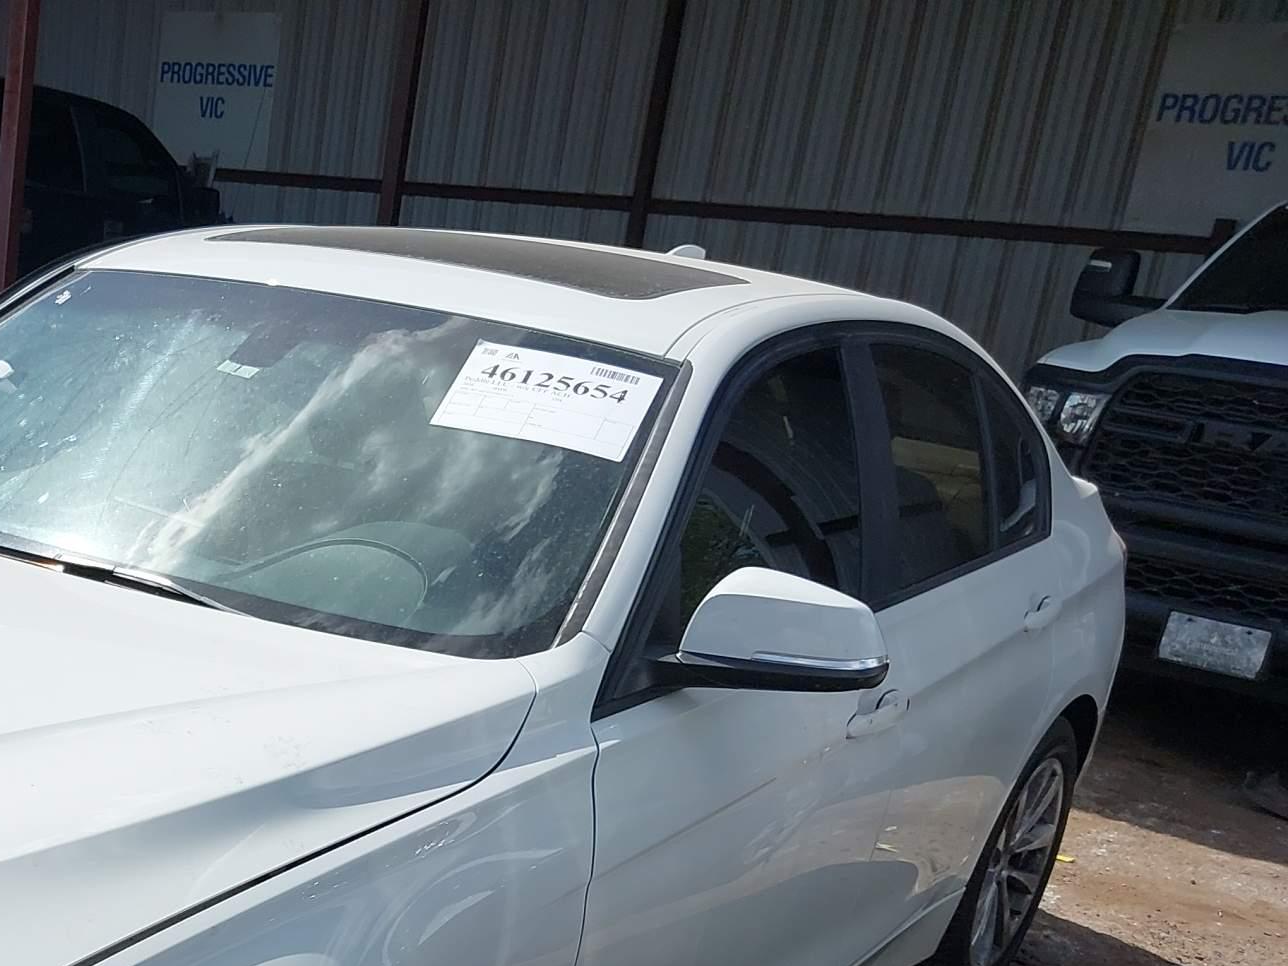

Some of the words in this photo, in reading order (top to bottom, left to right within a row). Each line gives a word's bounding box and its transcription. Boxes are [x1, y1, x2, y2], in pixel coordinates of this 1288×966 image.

[159, 61, 275, 88] PROGRESSIVE
[199, 96, 225, 119] VIC
[1155, 93, 1288, 127] PROGRE
[1226, 140, 1276, 172] VIC
[480, 363, 630, 404] 46125654
